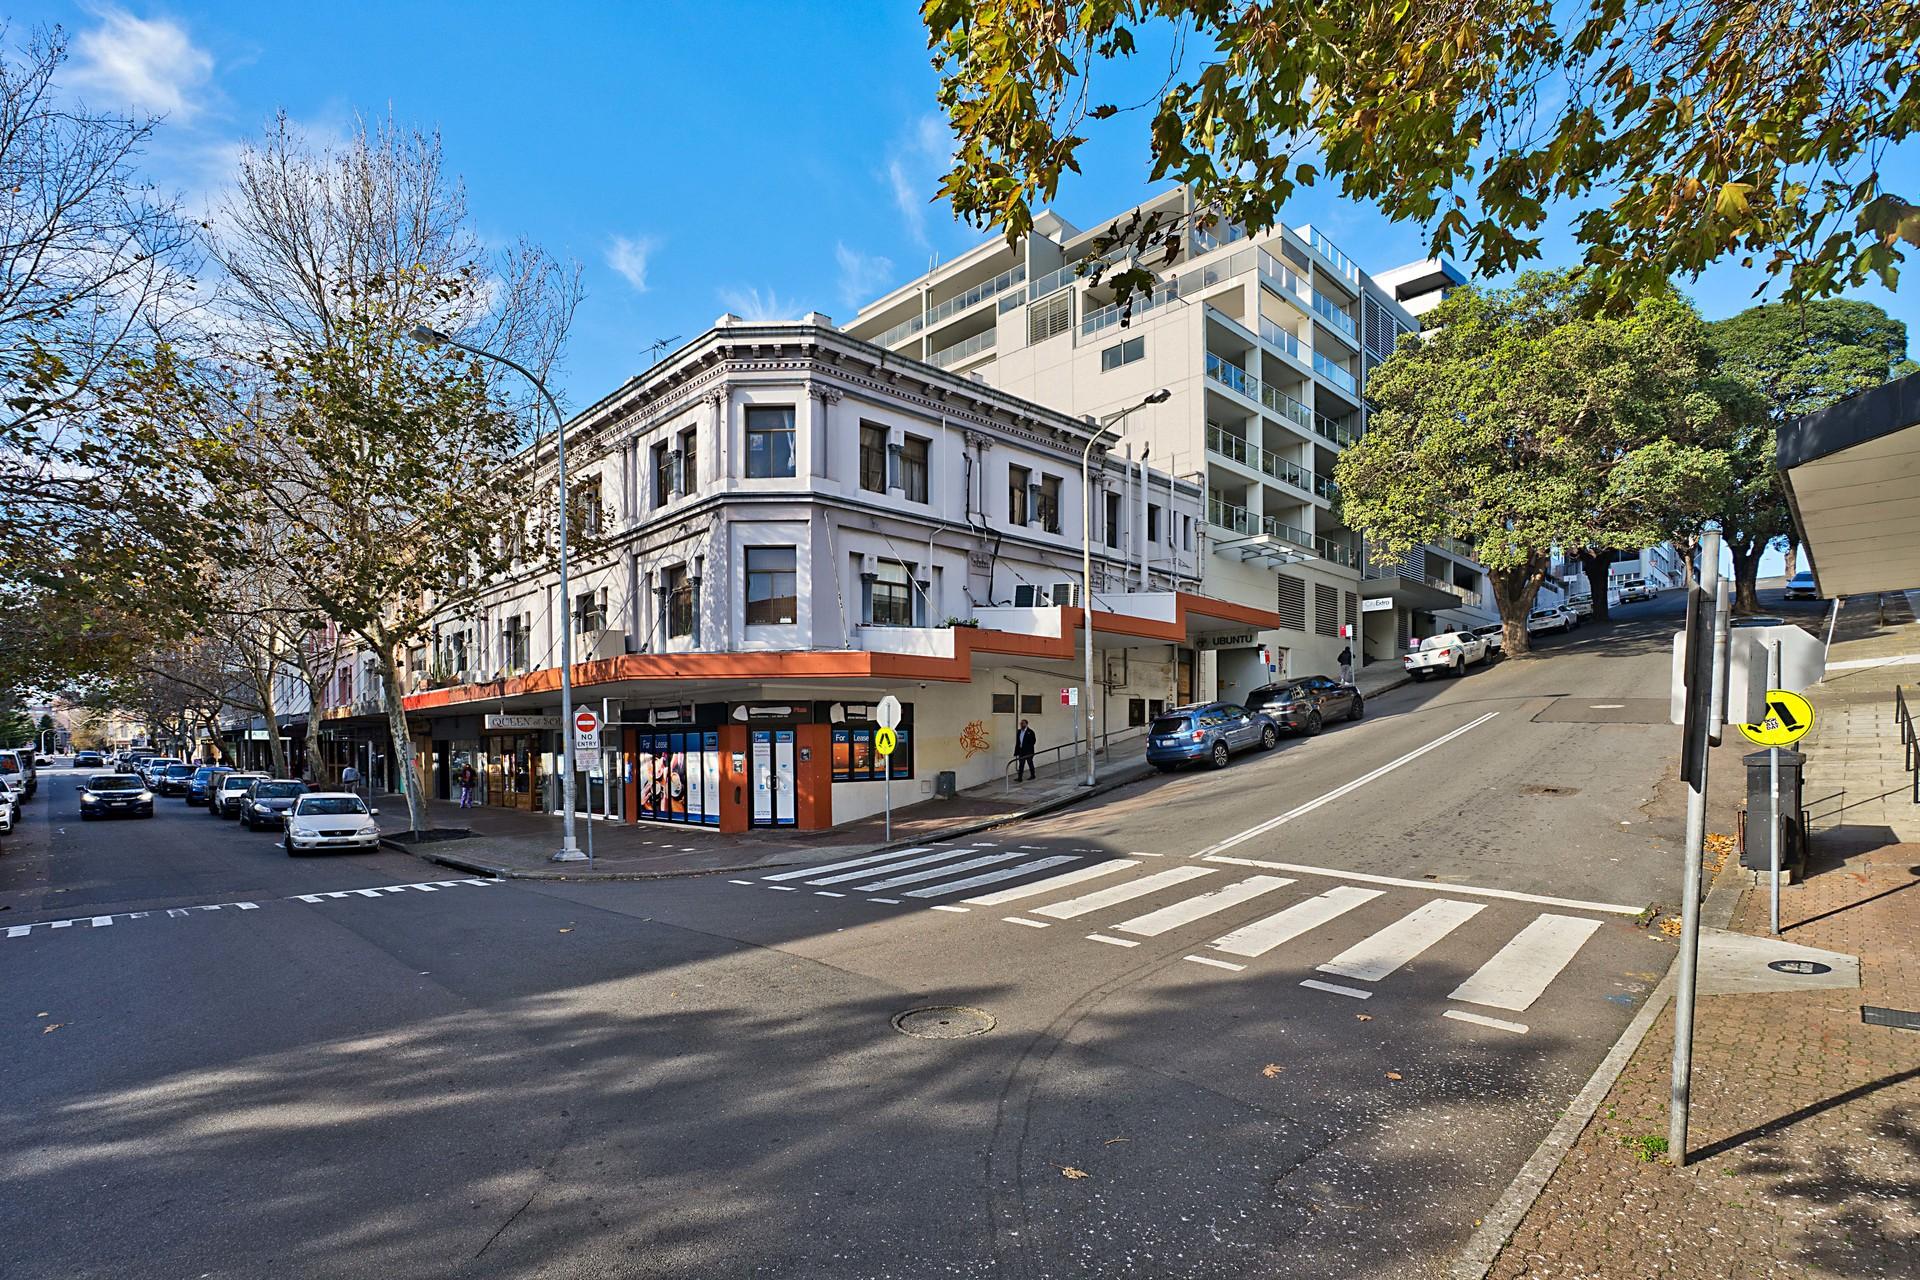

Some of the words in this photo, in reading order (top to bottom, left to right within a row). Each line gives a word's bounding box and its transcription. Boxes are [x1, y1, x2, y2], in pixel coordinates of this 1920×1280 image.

[1212, 635, 1253, 646] UBUNTU
[492, 717, 532, 728] QUEEN
[642, 740, 650, 748] For
[655, 740, 668, 748] Lease
